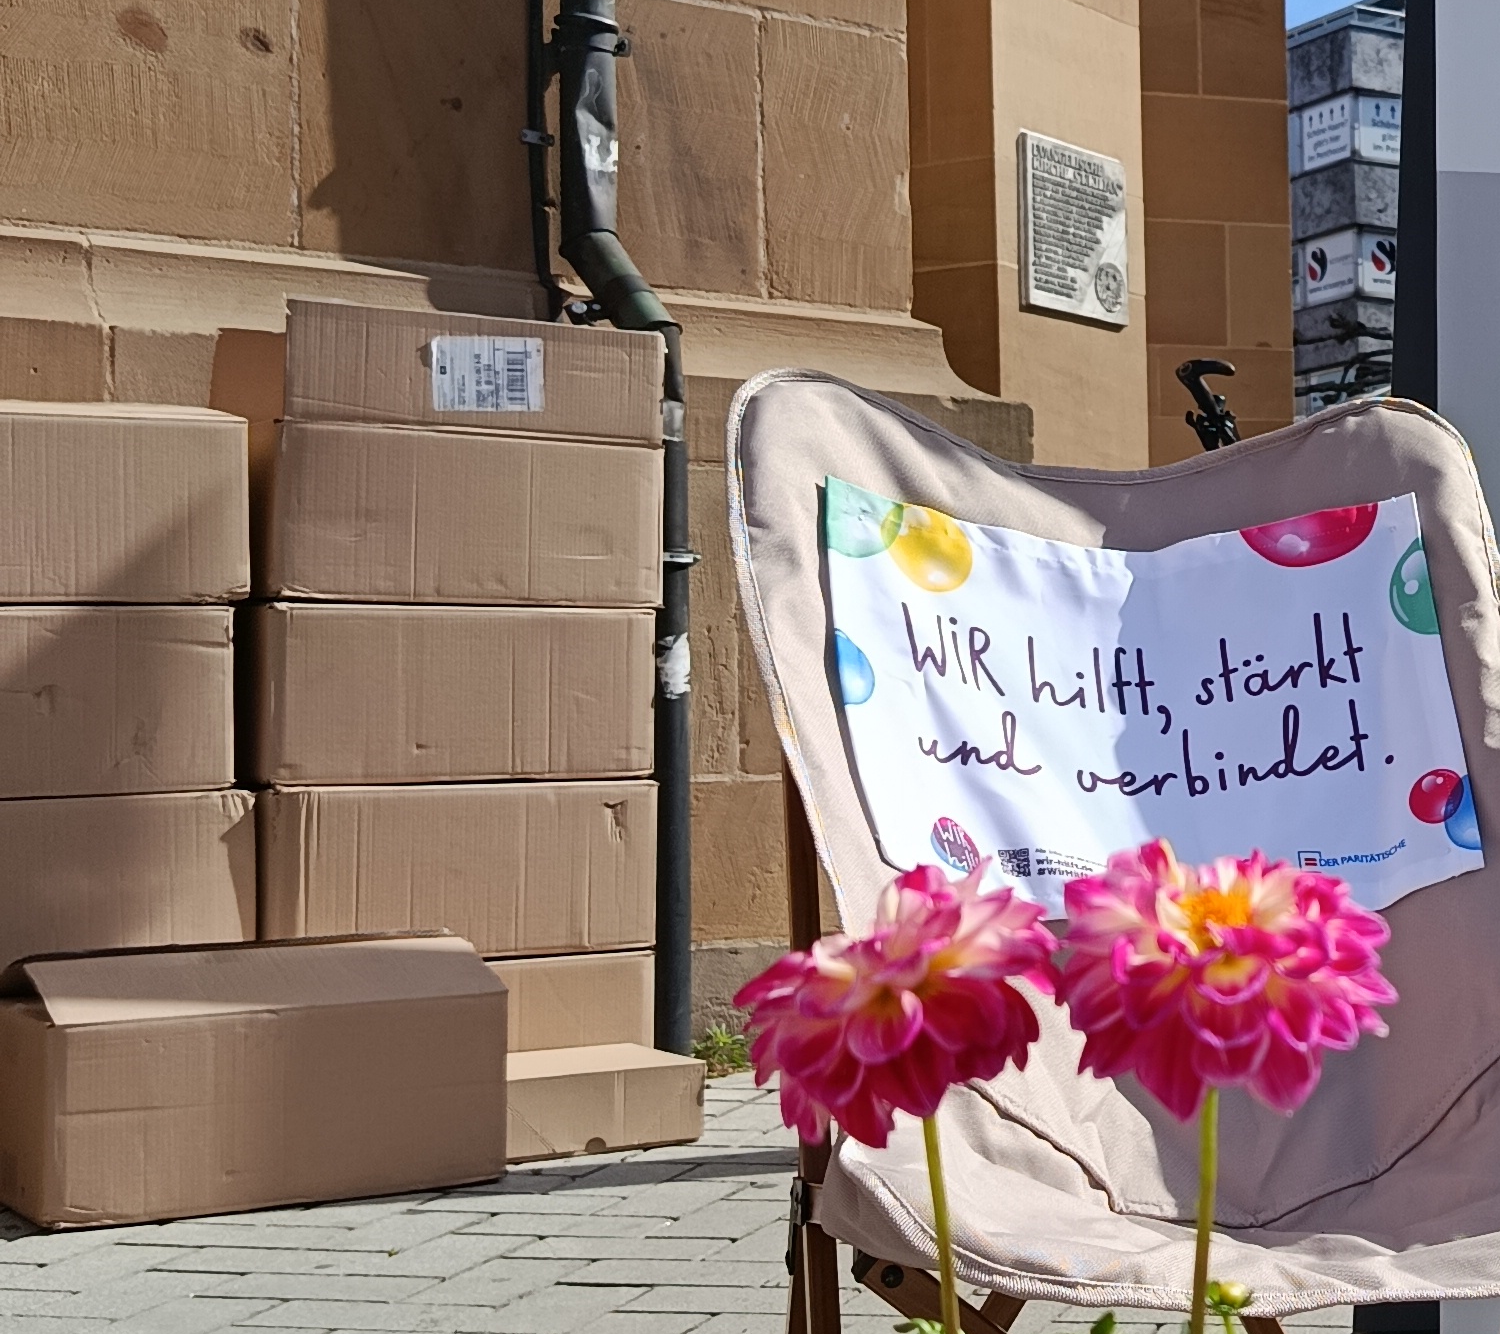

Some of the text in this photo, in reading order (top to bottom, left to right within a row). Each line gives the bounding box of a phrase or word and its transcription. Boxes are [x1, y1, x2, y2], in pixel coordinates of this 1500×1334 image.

[1027, 635, 1173, 734] hilft,
[1195, 612, 1364, 707] stärkt
[917, 699, 1395, 798] und verbindet.
[1319, 838, 1407, 867] DER PARITÄTISCHE
